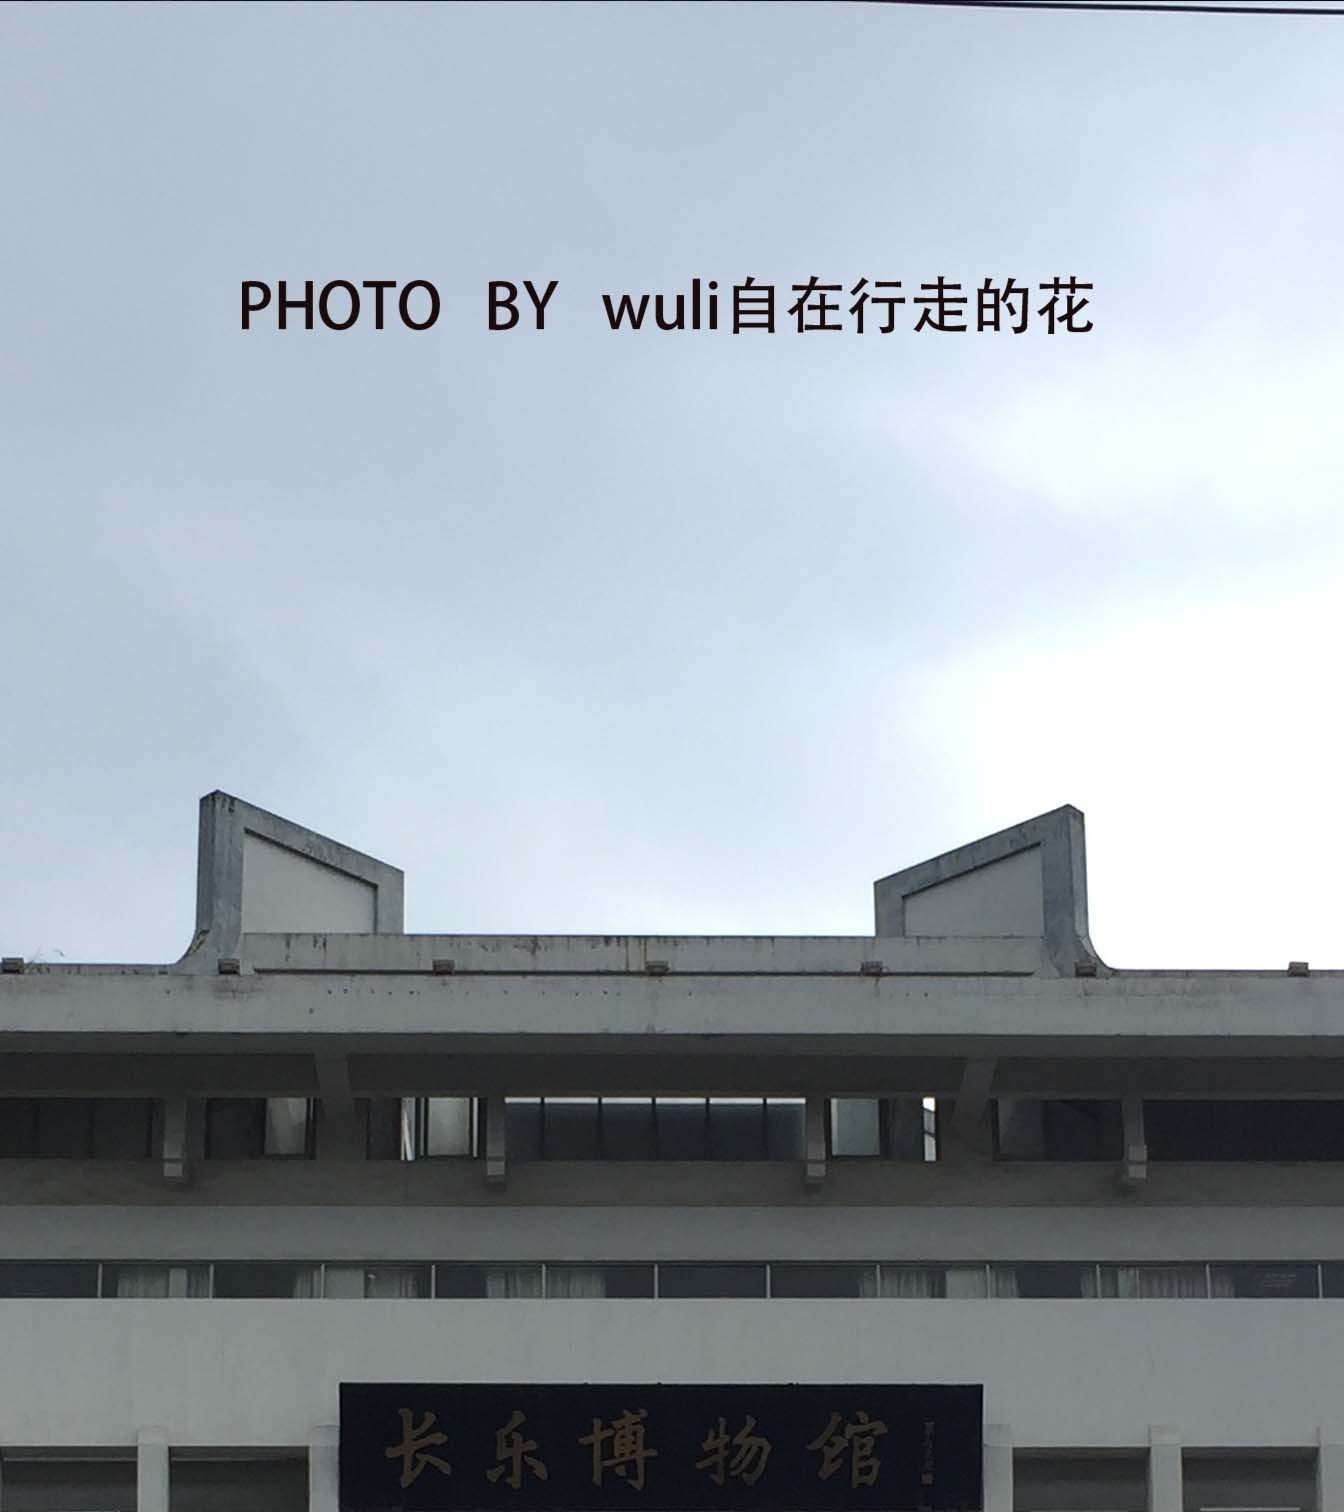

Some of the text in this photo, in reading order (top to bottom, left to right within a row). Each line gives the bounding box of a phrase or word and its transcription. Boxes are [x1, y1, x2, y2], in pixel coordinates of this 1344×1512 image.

[384, 1407, 889, 1489] 长乐博物馆
